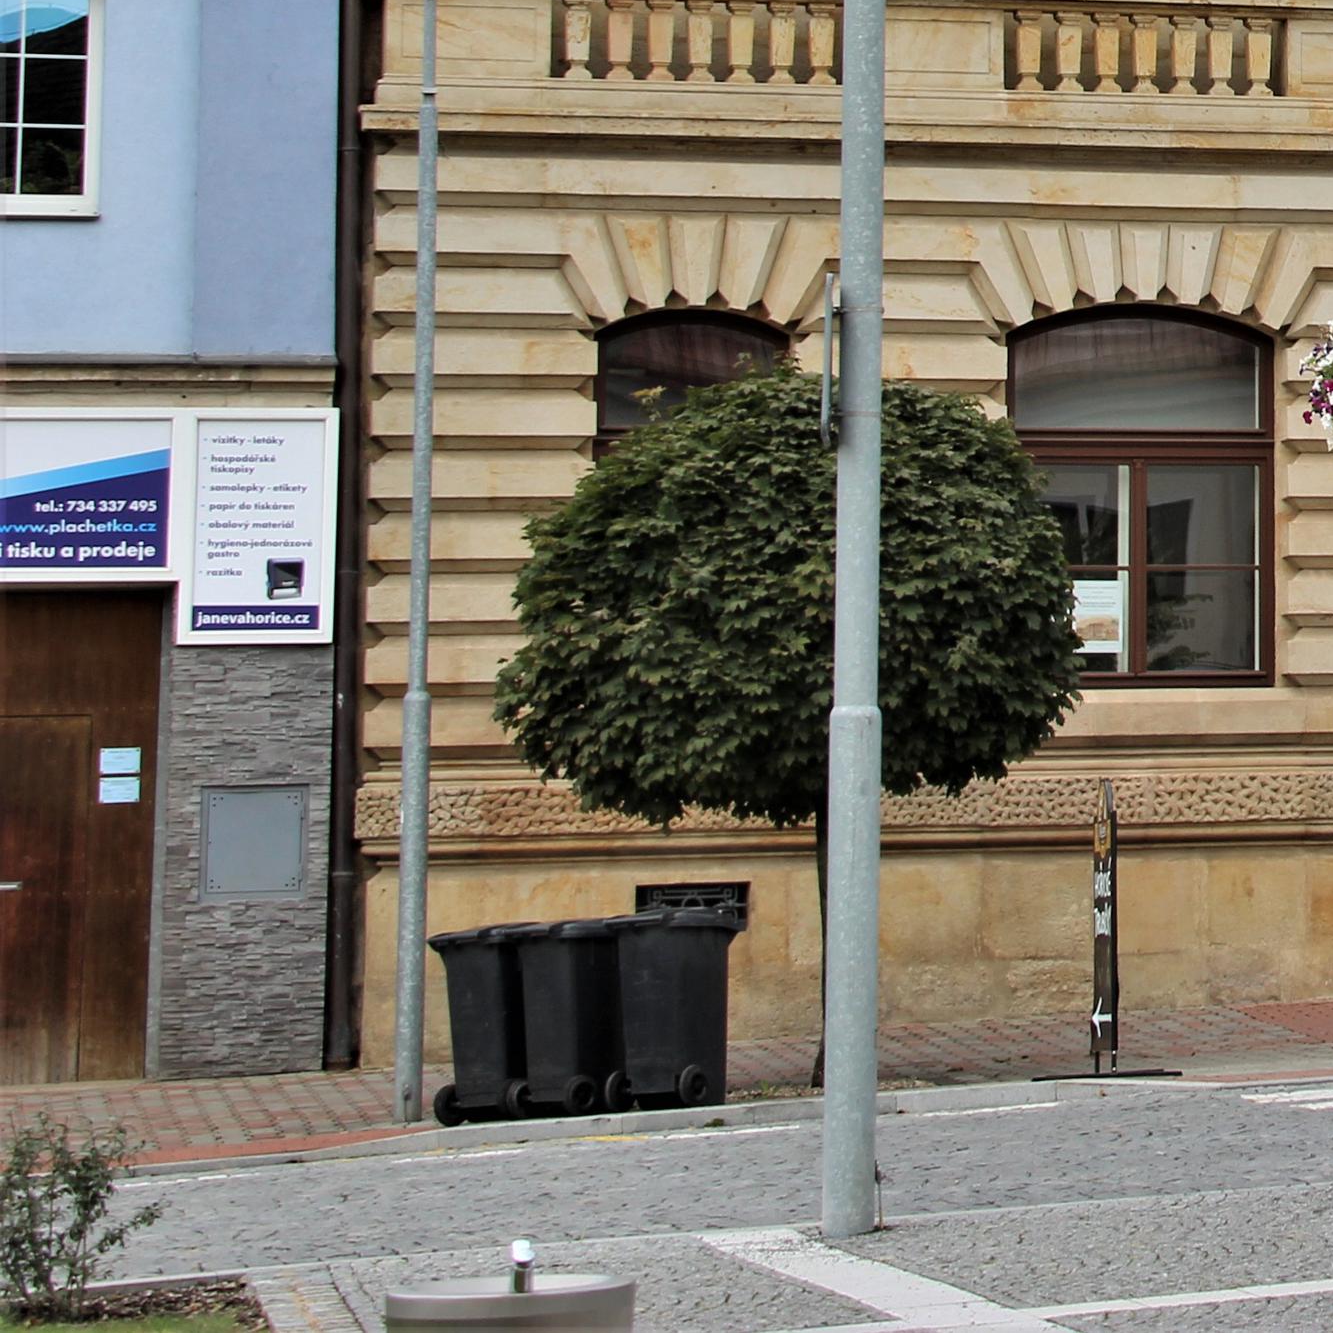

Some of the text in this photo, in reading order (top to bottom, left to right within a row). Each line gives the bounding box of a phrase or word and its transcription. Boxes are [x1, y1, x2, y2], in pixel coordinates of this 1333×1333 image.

[210, 465, 255, 475] tiskopisy
[209, 483, 265, 494] samolepky
[273, 484, 308, 494] etikety
[34, 500, 158, 513] tel.: 734 337 495
[238, 502, 252, 510] do
[0, 518, 157, 536] www.plachetka.cz
[208, 520, 295, 530] obalový materiál
[7, 541, 56, 559] tisku
[60, 545, 75, 558] a
[78, 540, 157, 562] prodeje
[207, 550, 241, 560] gastro
[195, 611, 310, 628] janevahorice.cz
